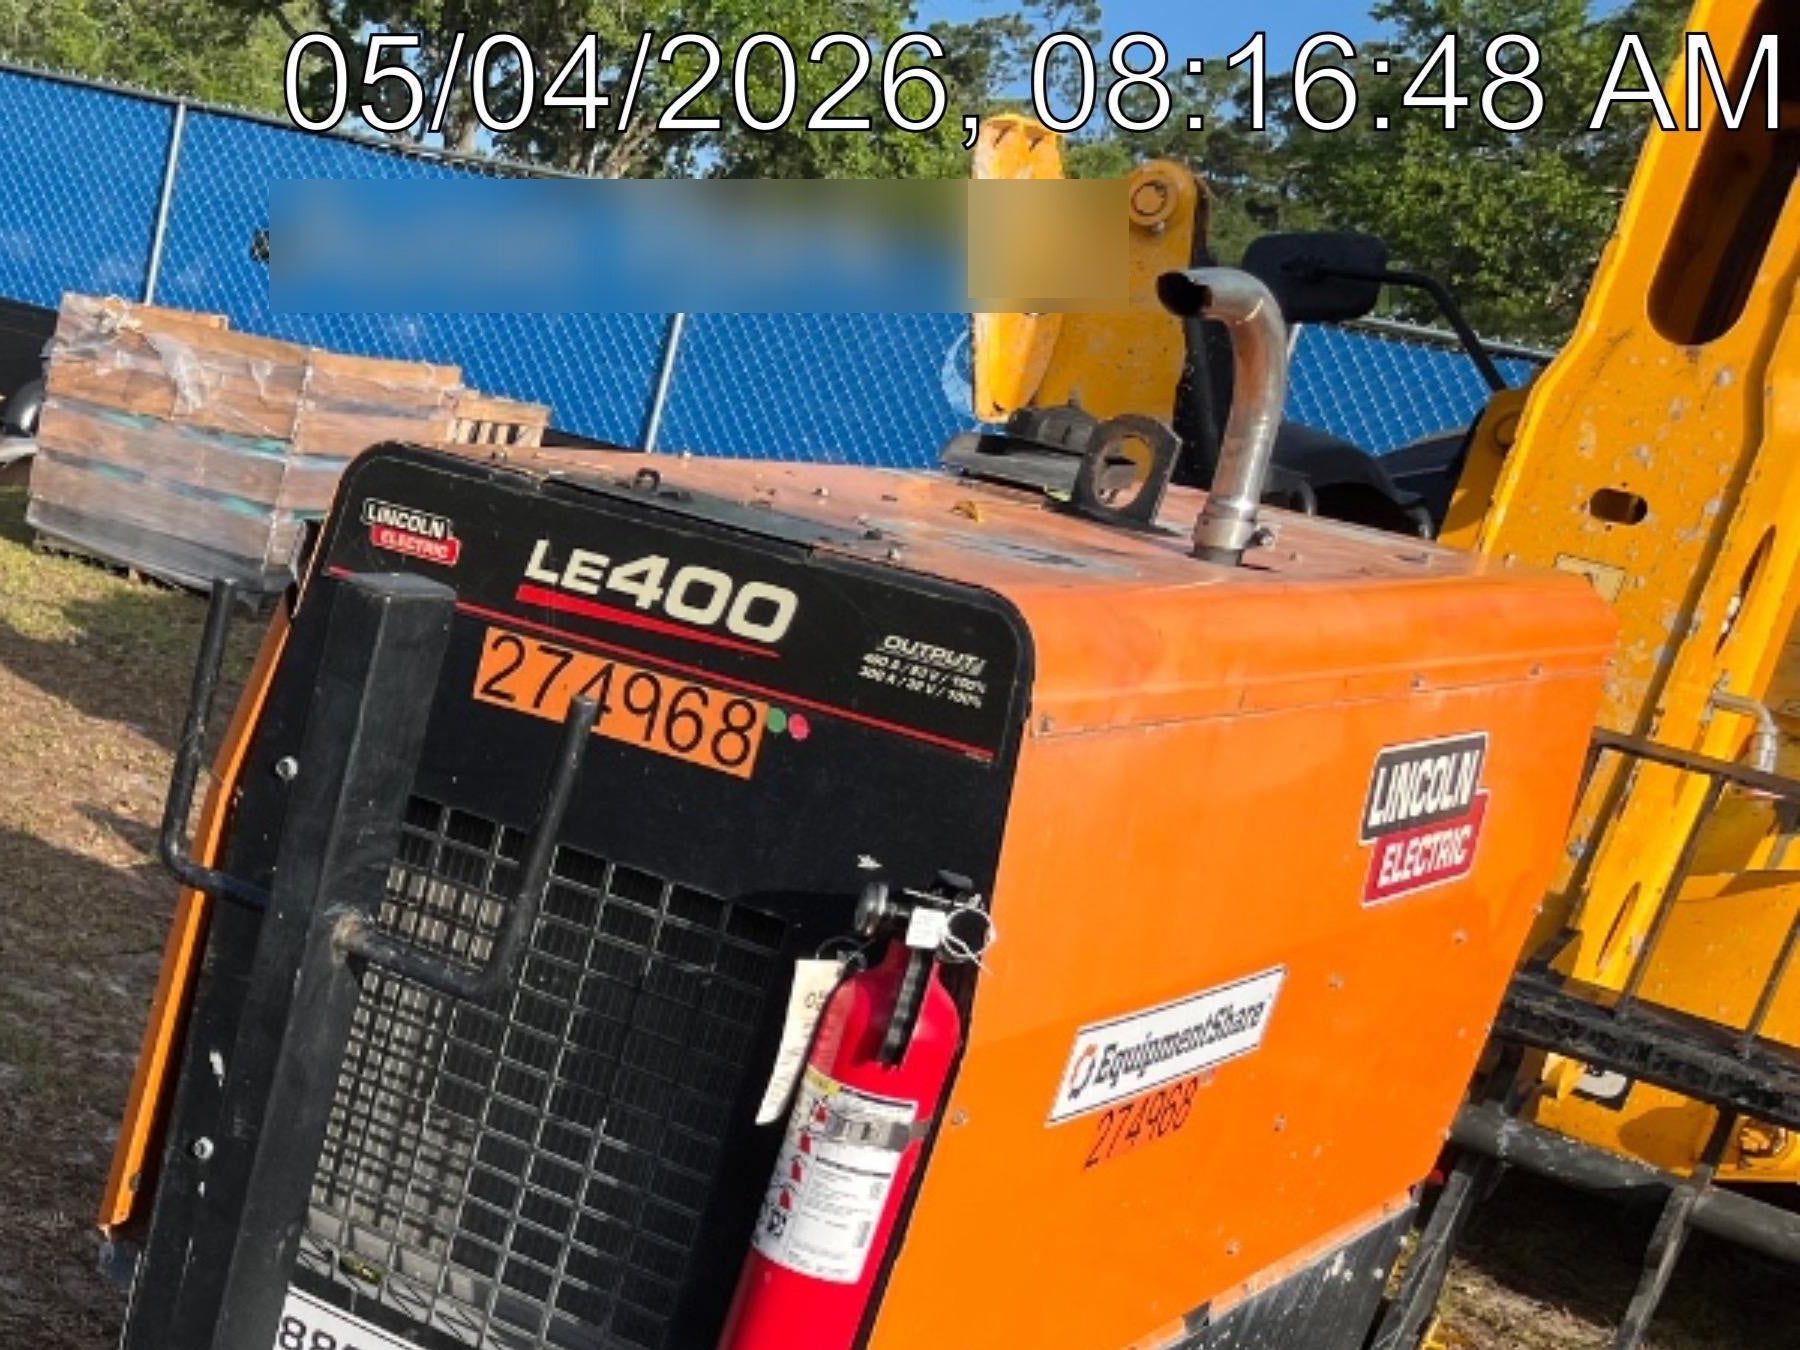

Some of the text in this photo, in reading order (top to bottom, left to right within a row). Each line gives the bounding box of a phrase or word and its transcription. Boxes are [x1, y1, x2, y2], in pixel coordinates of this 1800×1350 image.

[367, 503, 445, 540] LINCOLN
[380, 529, 450, 559] ELECTRIC
[524, 539, 799, 643] LE400
[480, 635, 757, 767] 274968
[1367, 749, 1481, 829] LINCOLN
[1376, 824, 1473, 889] ELECTRIC
[1092, 1001, 1266, 1089] EquipmentShare
[1083, 1075, 1199, 1170] 274968
